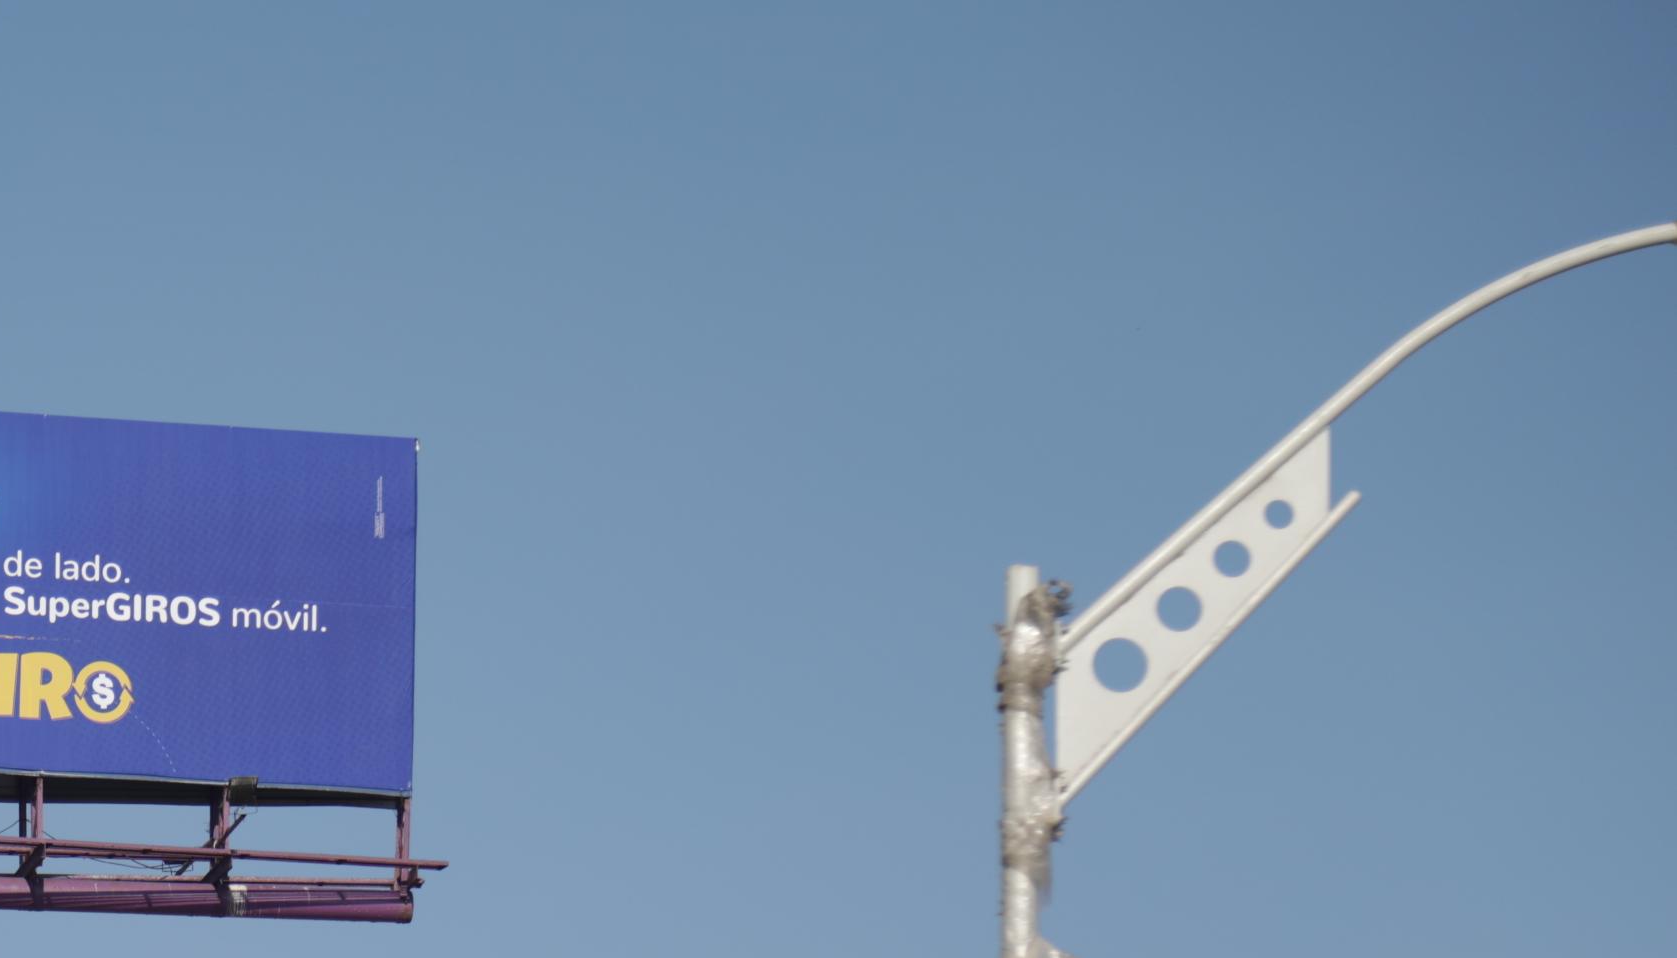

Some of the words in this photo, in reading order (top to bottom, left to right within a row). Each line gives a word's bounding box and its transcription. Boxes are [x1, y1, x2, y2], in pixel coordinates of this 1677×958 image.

[3, 549, 43, 579] de
[54, 551, 131, 584] lado.
[3, 585, 221, 627] SuperGIROS
[231, 599, 327, 633] móvil.
